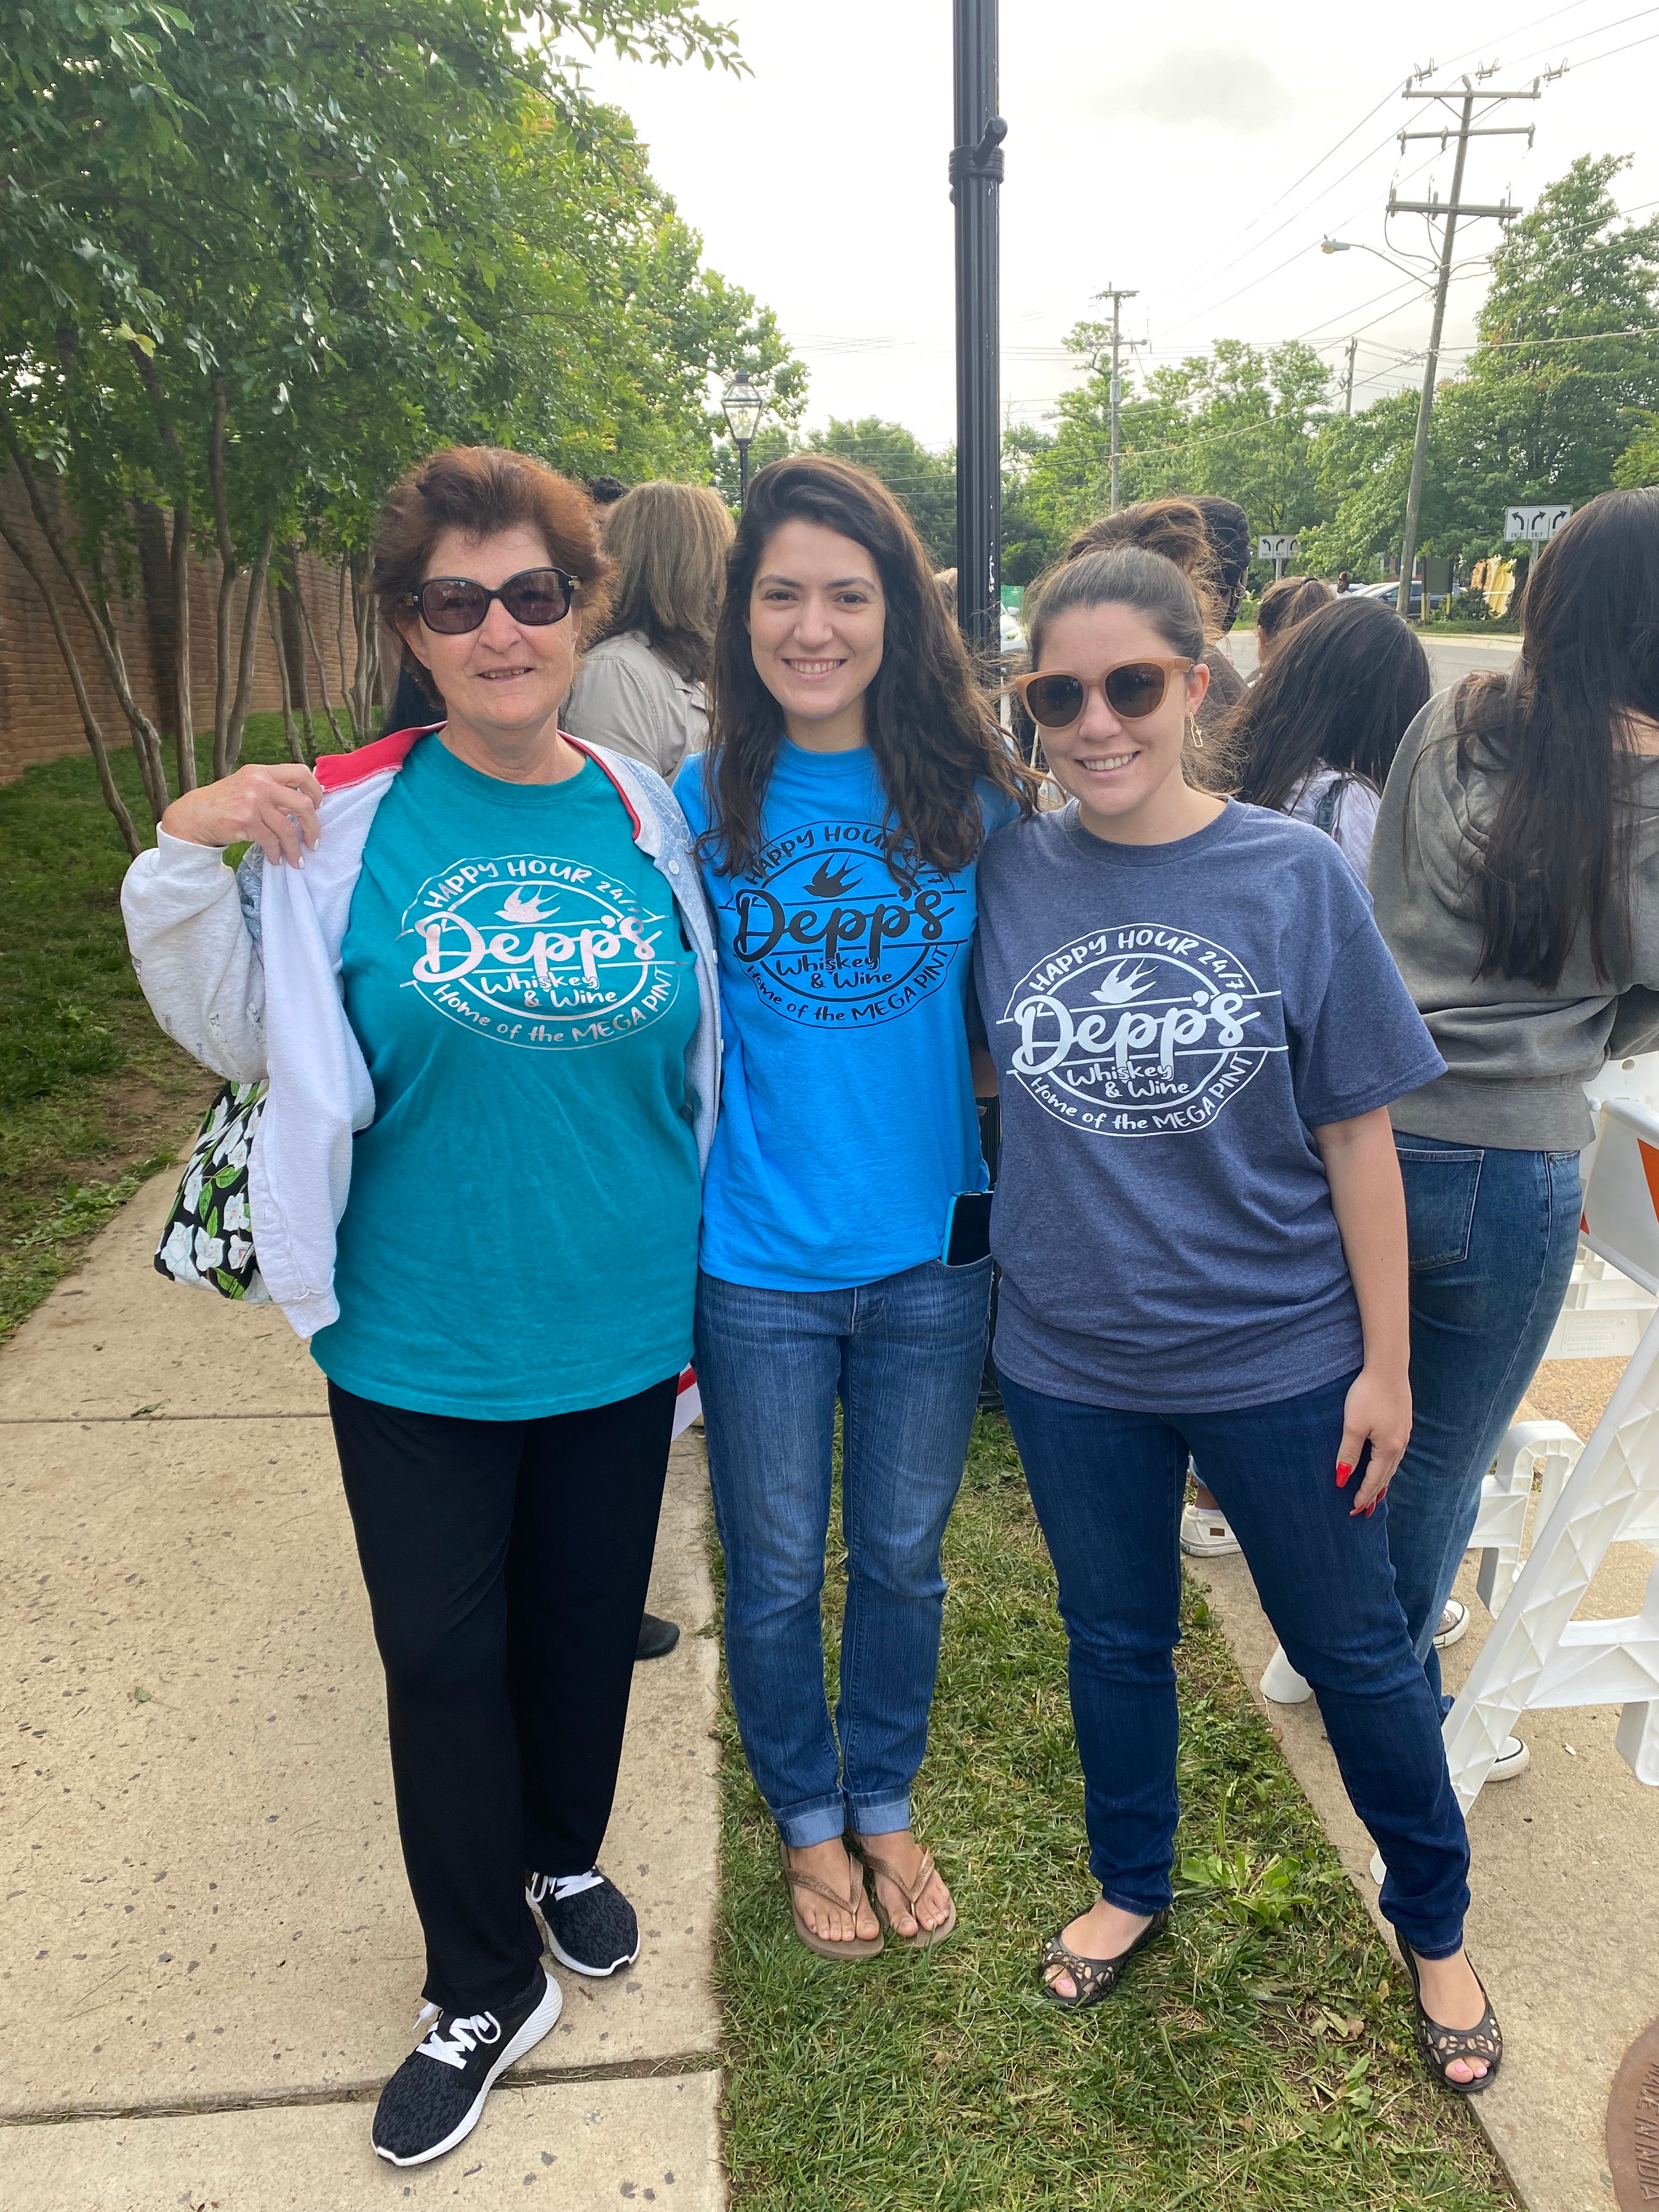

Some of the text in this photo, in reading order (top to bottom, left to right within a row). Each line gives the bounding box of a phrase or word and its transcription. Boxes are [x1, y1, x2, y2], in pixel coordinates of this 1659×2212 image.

[424, 860, 498, 907] HAPPY
[507, 859, 592, 883] HOUR
[413, 911, 662, 983] Depp's
[733, 888, 956, 963] Depp's
[481, 972, 600, 994] Whiskey
[746, 947, 949, 1022] Home of the MEGA PINT
[776, 952, 880, 977] Whiskey
[810, 970, 893, 989] & Wine
[1029, 929, 1246, 991] HAPPY HOUR 24/7
[433, 965, 673, 1043] Home of the MEGA PINT
[524, 988, 618, 1008] & Wine
[1012, 991, 1261, 1080] Depp's
[1030, 1051, 1254, 1131] Home of the MEGA PINT
[1066, 1061, 1175, 1086] Whiskey
[1104, 1080, 1190, 1098] & Wine
